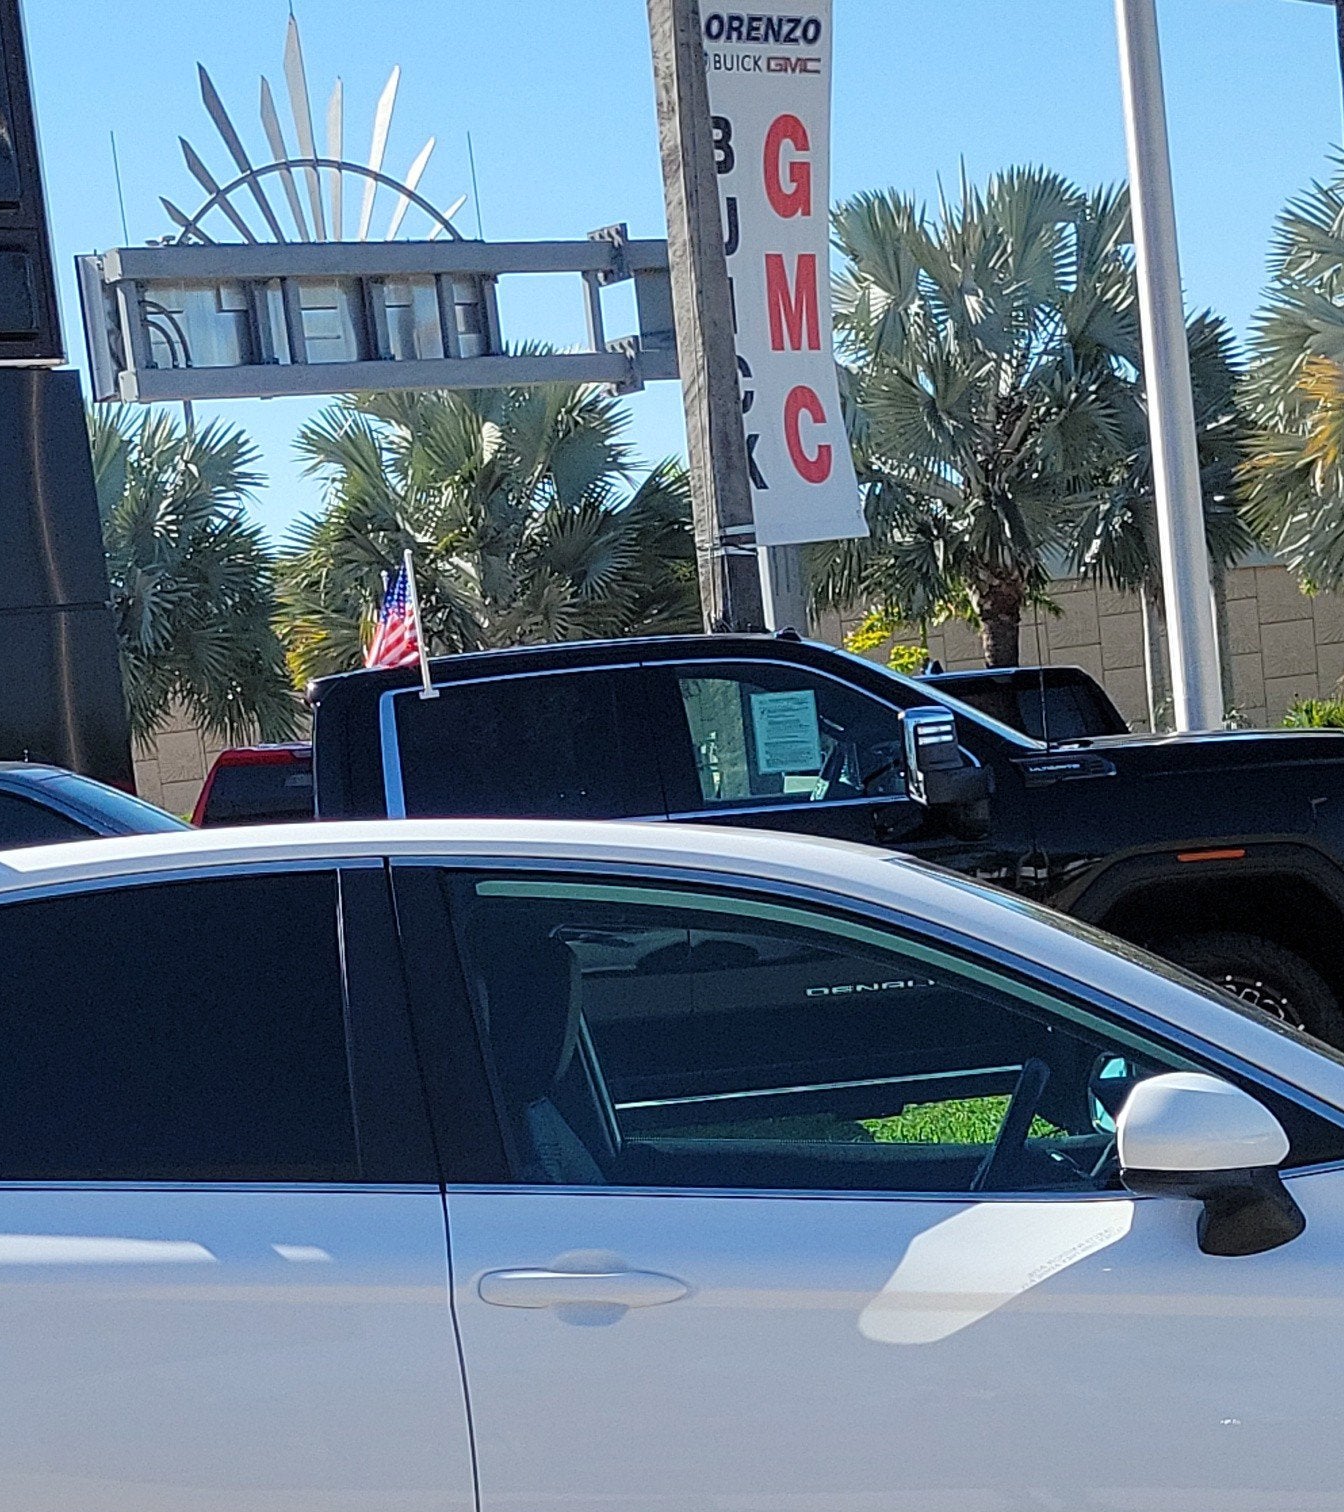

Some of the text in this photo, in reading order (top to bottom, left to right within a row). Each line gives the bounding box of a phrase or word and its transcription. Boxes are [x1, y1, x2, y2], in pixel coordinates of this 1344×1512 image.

[713, 52, 822, 75] BUICK GMC
[762, 113, 833, 485] GMC
